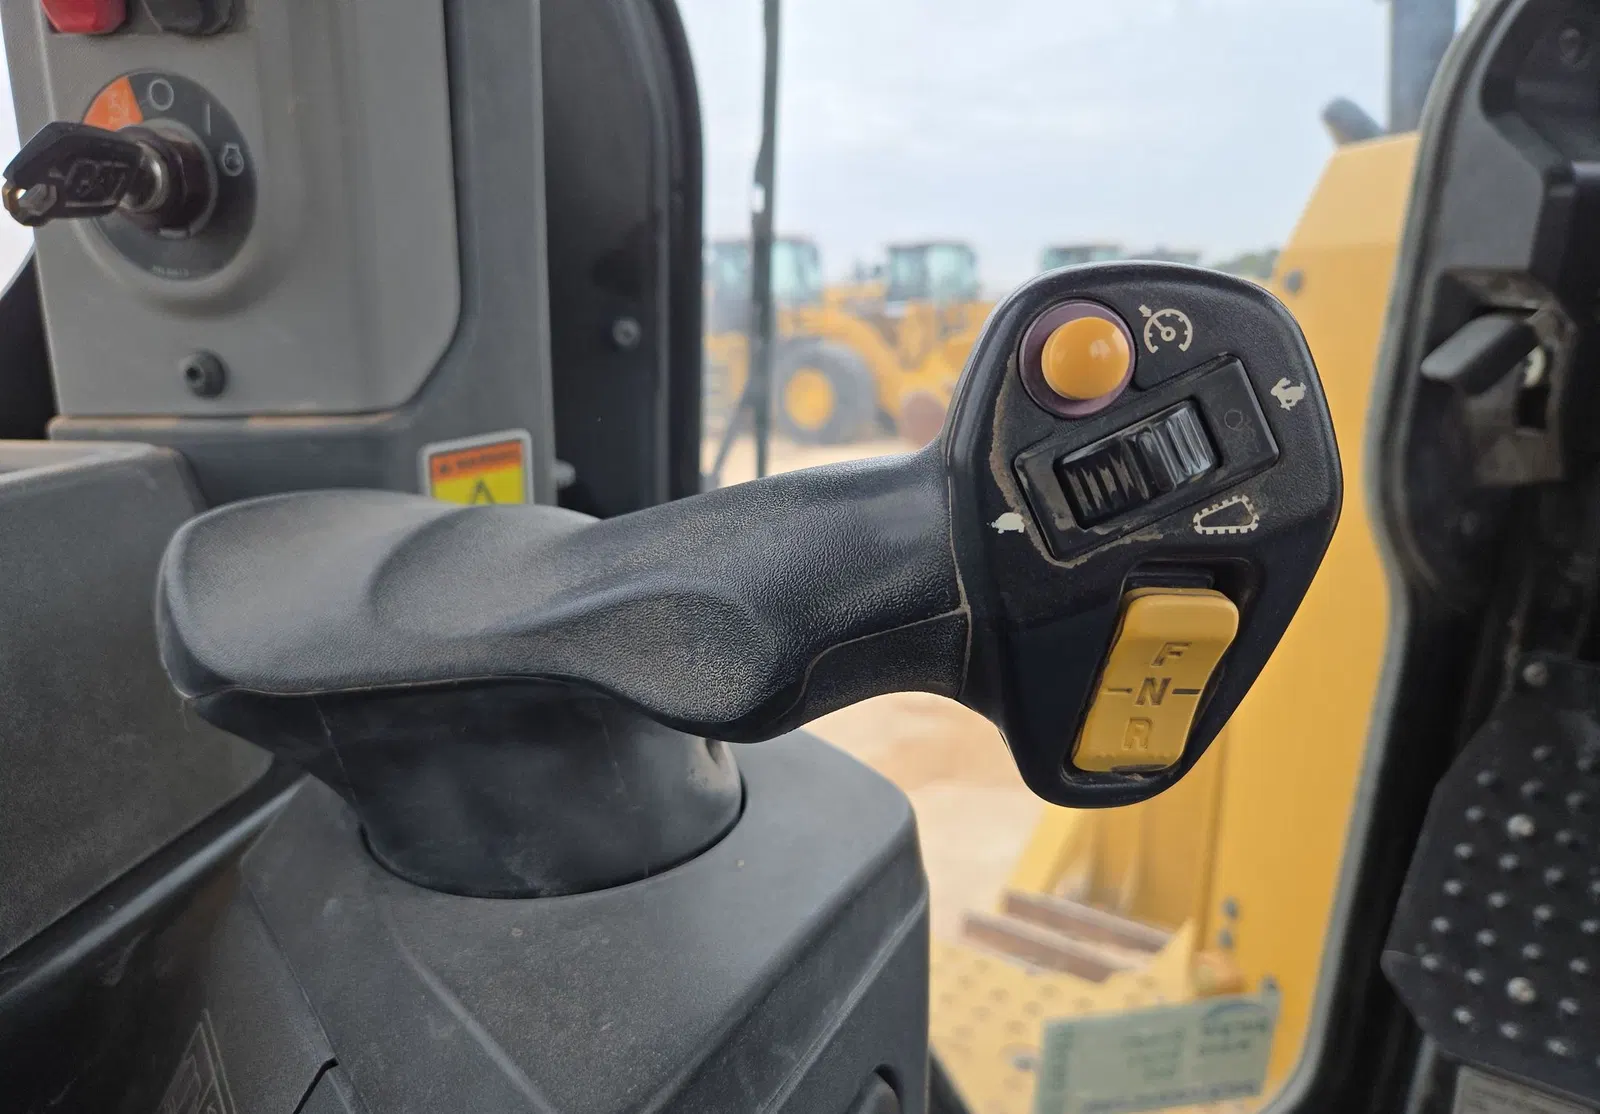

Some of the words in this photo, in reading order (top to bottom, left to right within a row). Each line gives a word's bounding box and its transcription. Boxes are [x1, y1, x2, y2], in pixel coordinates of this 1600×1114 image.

[1151, 641, 1192, 667] F
[1135, 677, 1172, 706] N
[1122, 716, 1154, 749] R
